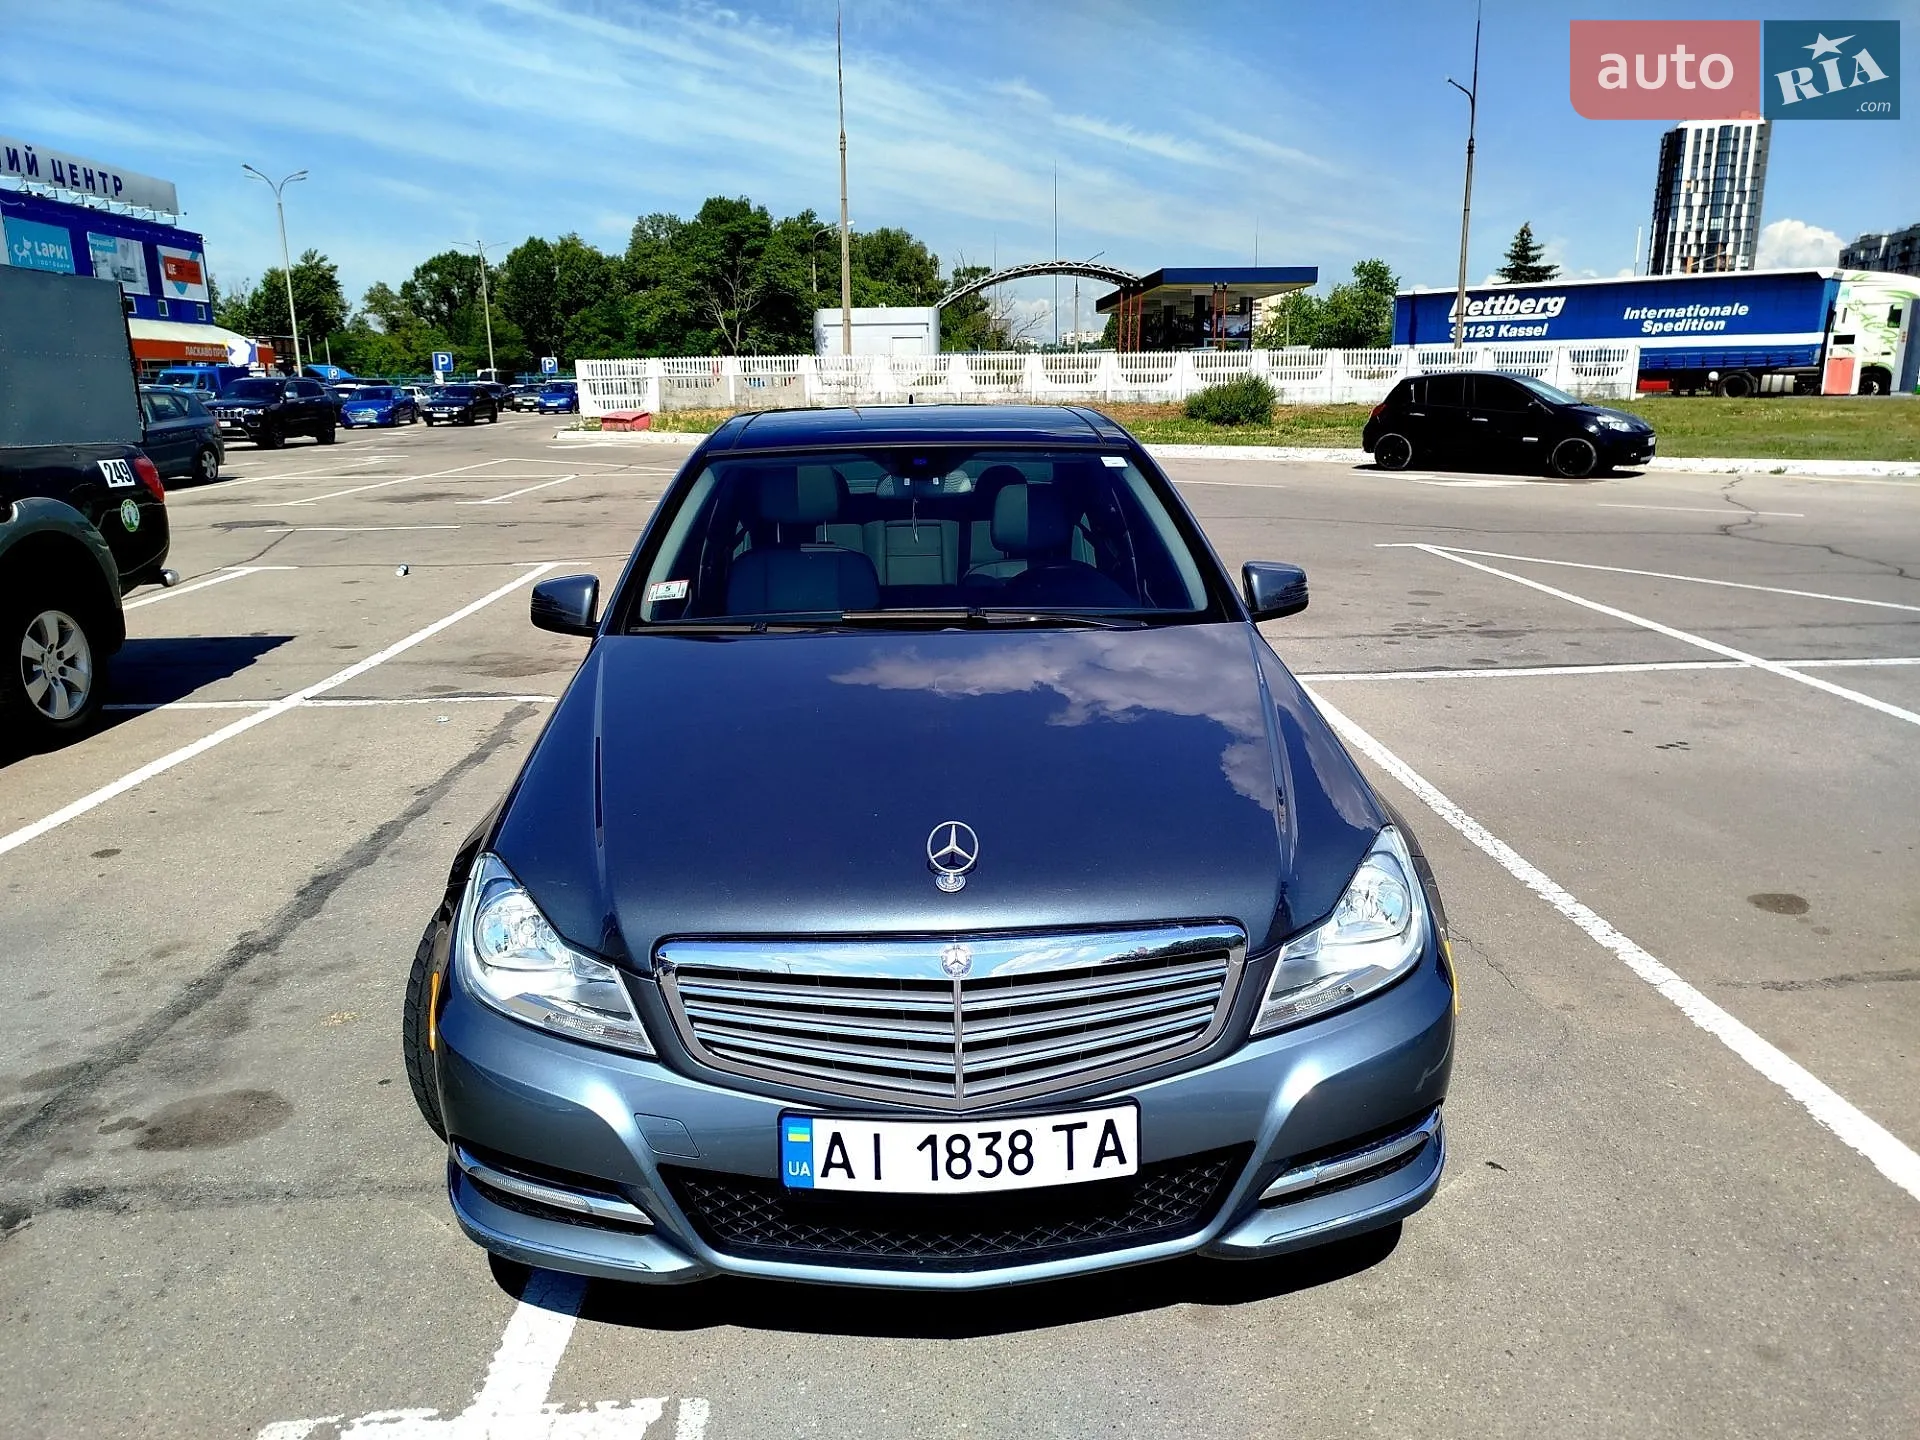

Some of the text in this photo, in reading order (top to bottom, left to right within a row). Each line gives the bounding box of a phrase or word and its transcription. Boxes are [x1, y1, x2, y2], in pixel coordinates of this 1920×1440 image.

[0, 144, 122, 196] ИЙ ЦЕНТР
[1448, 294, 1567, 318] Rettberg
[1623, 302, 1749, 320] Internationale
[1498, 322, 1549, 338] Kassel
[1641, 318, 1726, 335] Spedition
[437, 354, 449, 370] P
[545, 359, 555, 371] P
[103, 461, 132, 484] 249
[820, 1118, 1127, 1182] AI 1838 TA
[788, 1161, 811, 1177] UA
